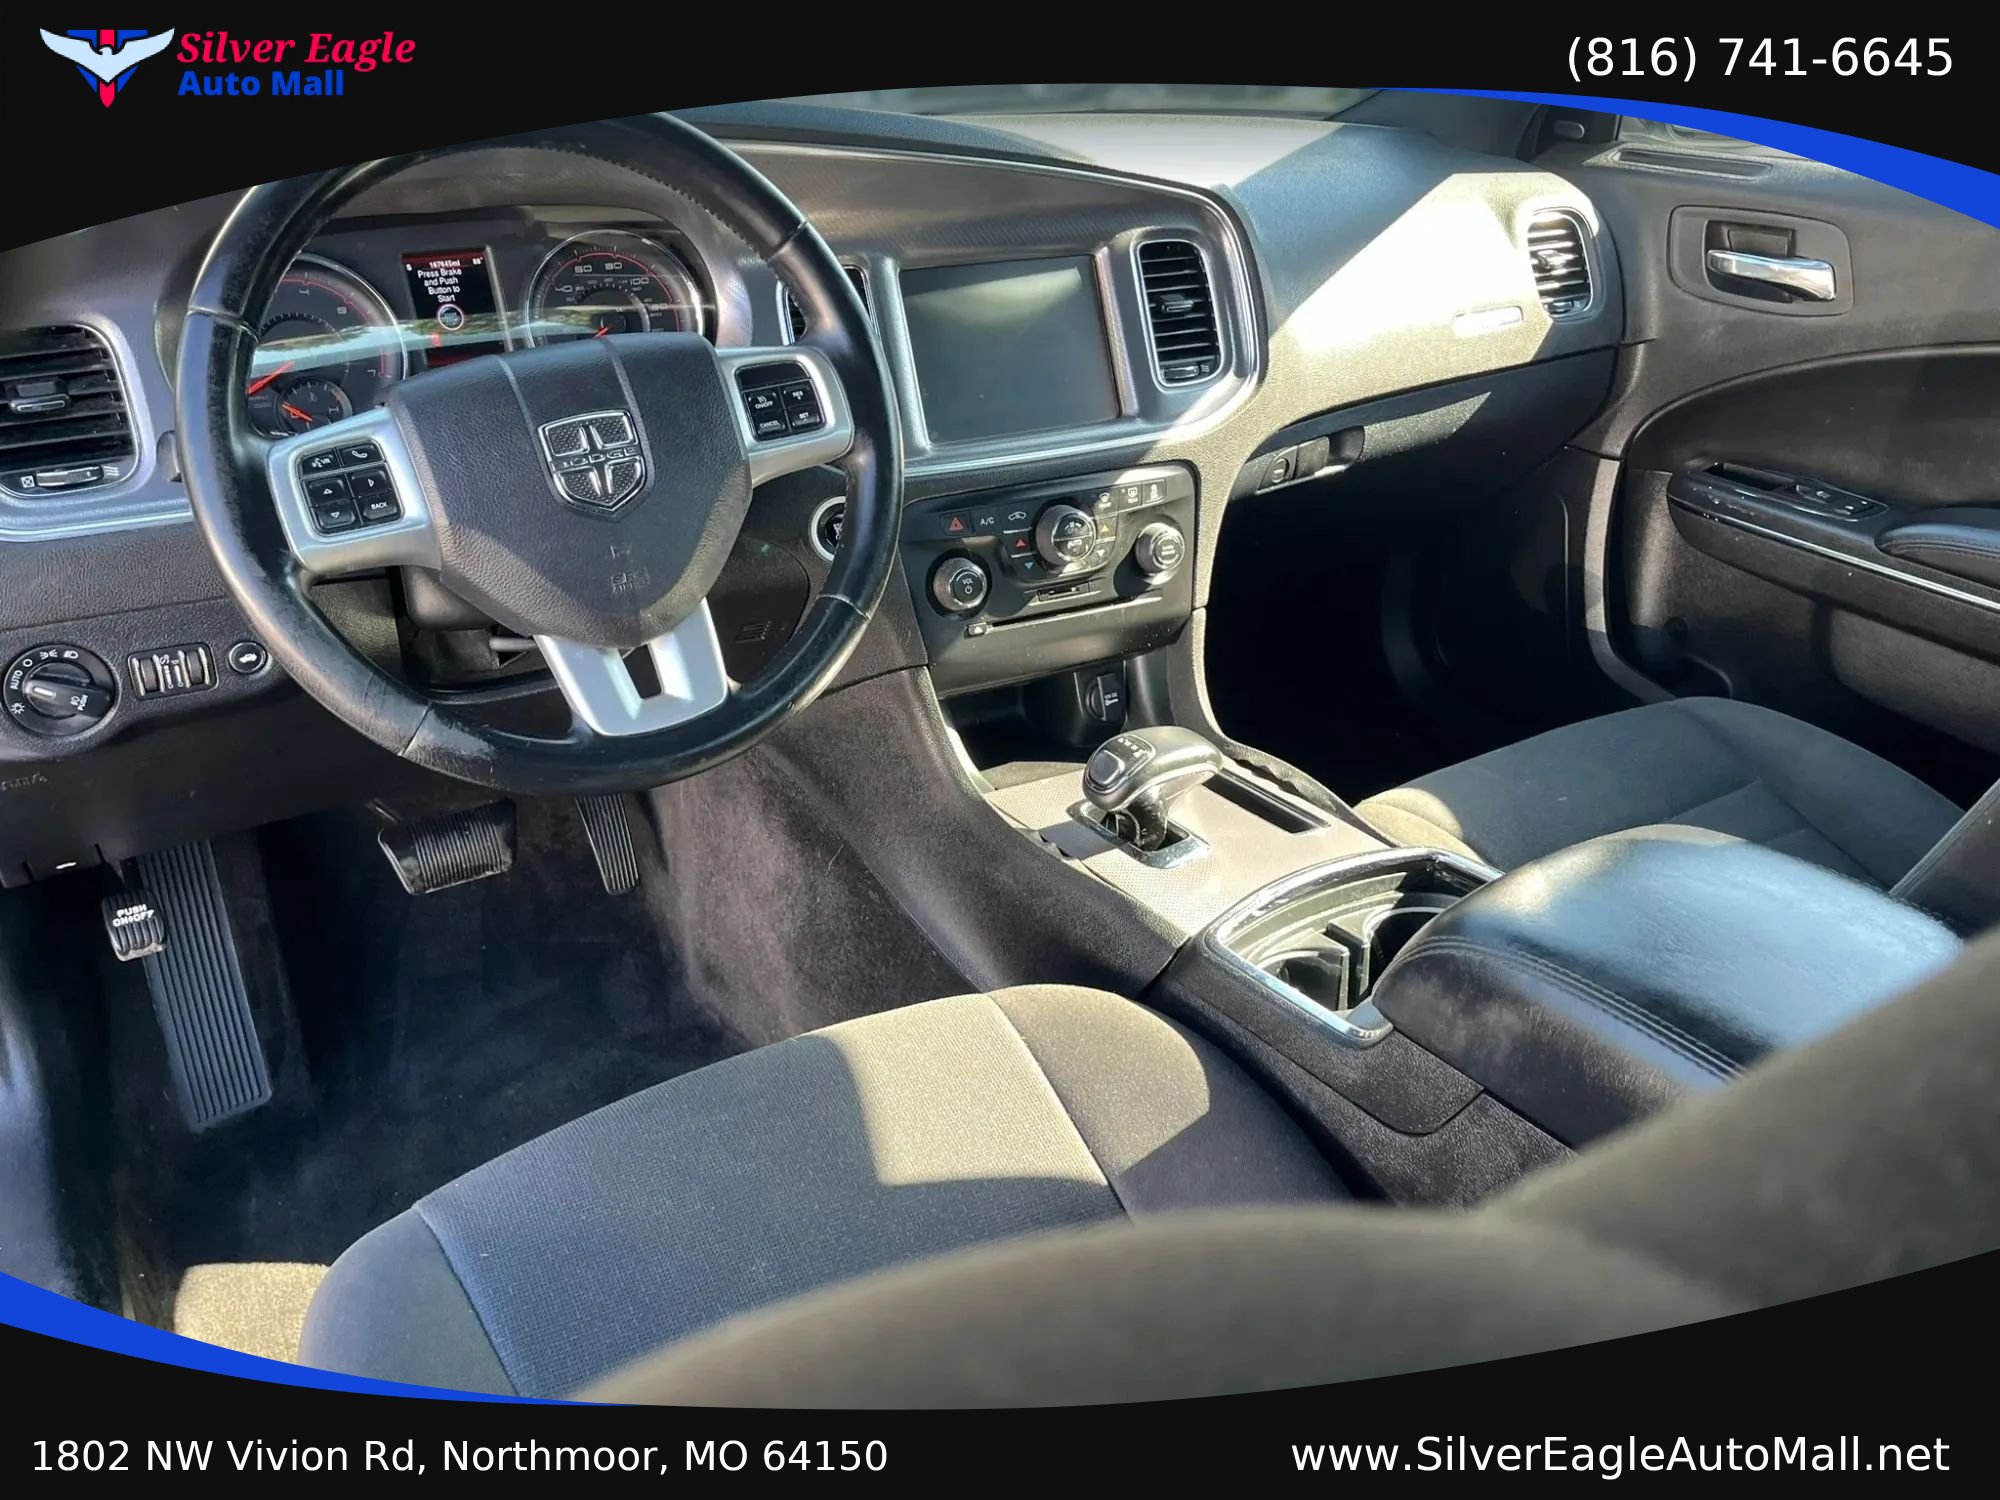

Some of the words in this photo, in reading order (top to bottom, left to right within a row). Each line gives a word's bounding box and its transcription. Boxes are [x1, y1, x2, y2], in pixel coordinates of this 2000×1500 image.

[417, 270, 439, 279] Press
[440, 268, 462, 277] Brake
[439, 277, 459, 286] Push
[428, 286, 452, 295] Button
[452, 285, 461, 293] to
[437, 294, 456, 303] Start
[760, 420, 780, 428] CANCEL
[552, 447, 637, 472] DODGE
[371, 502, 388, 510] BACK
[980, 515, 995, 526] A/C
[962, 577, 974, 585] VOL
[10, 669, 23, 690] AUTO
[116, 903, 147, 918] PUSH
